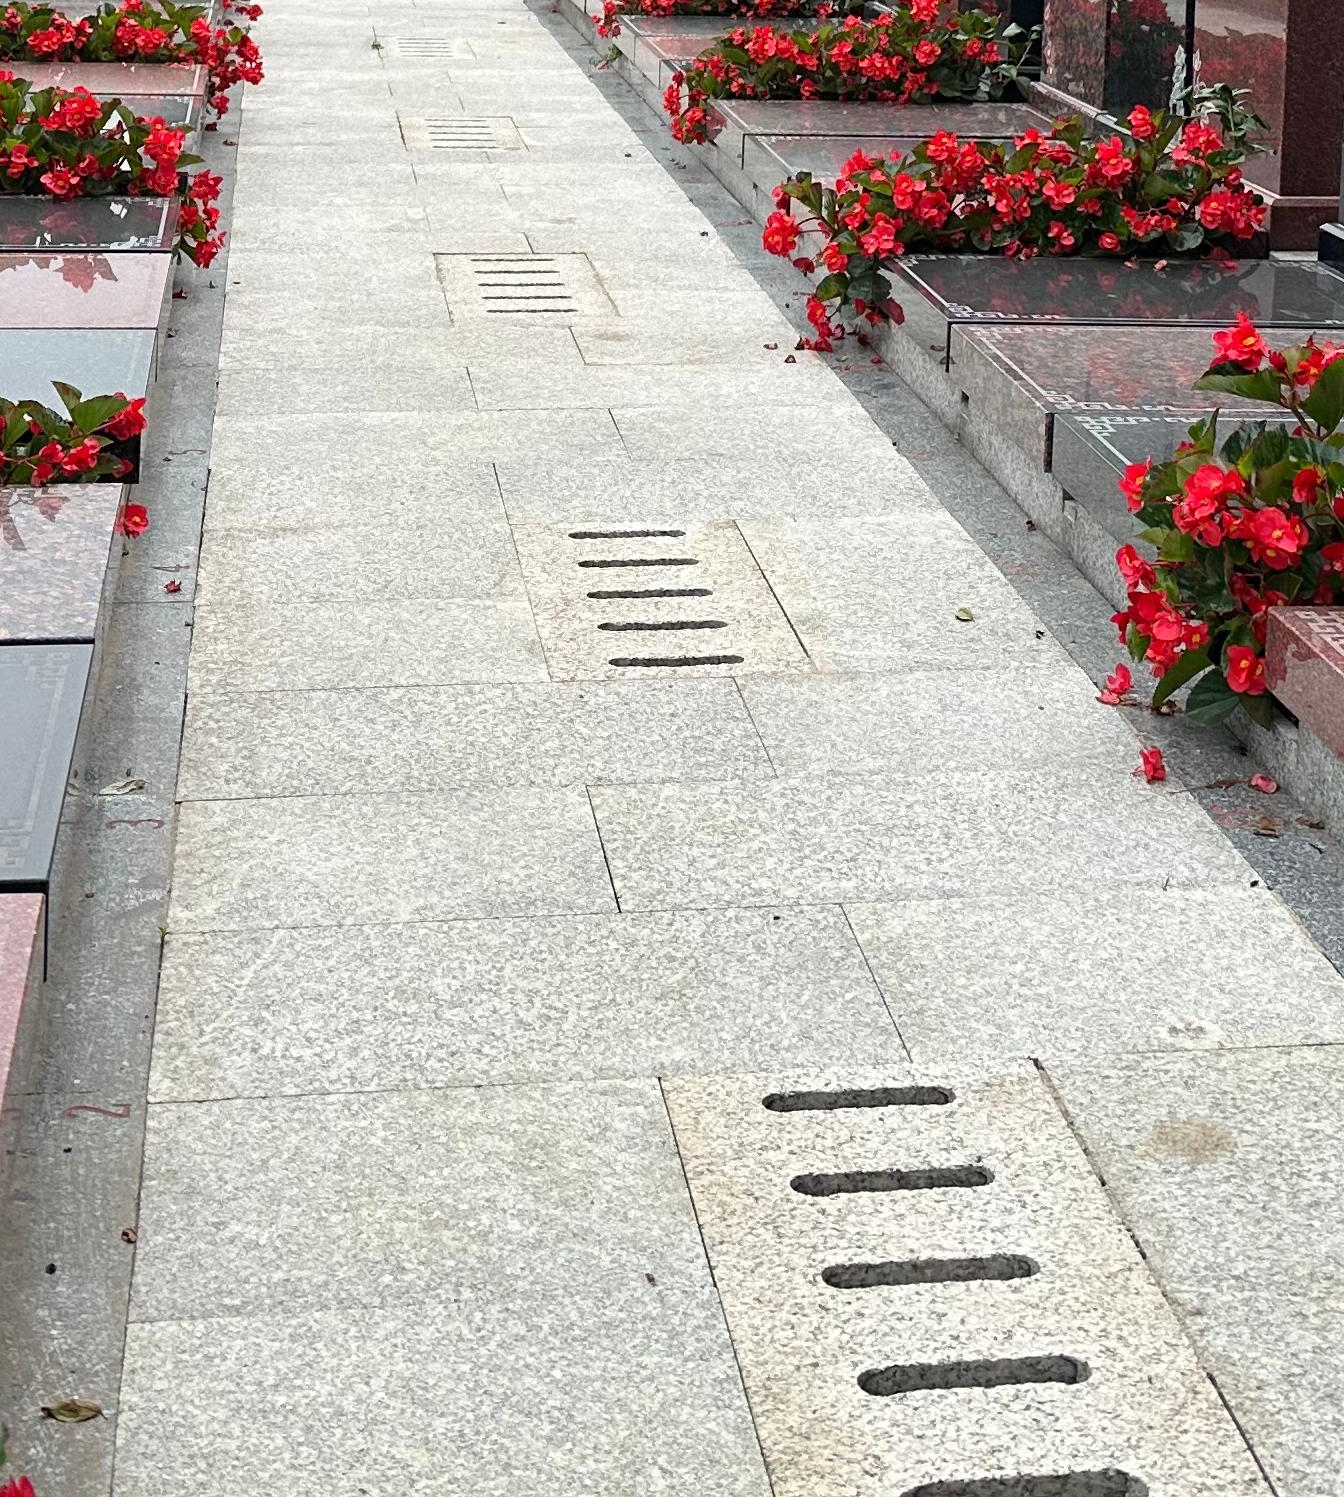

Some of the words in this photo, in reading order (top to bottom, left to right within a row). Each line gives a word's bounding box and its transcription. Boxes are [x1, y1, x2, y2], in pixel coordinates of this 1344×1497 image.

[150, 563, 191, 573] 4
[106, 817, 166, 830] 3
[62, 1103, 132, 1119] 2
